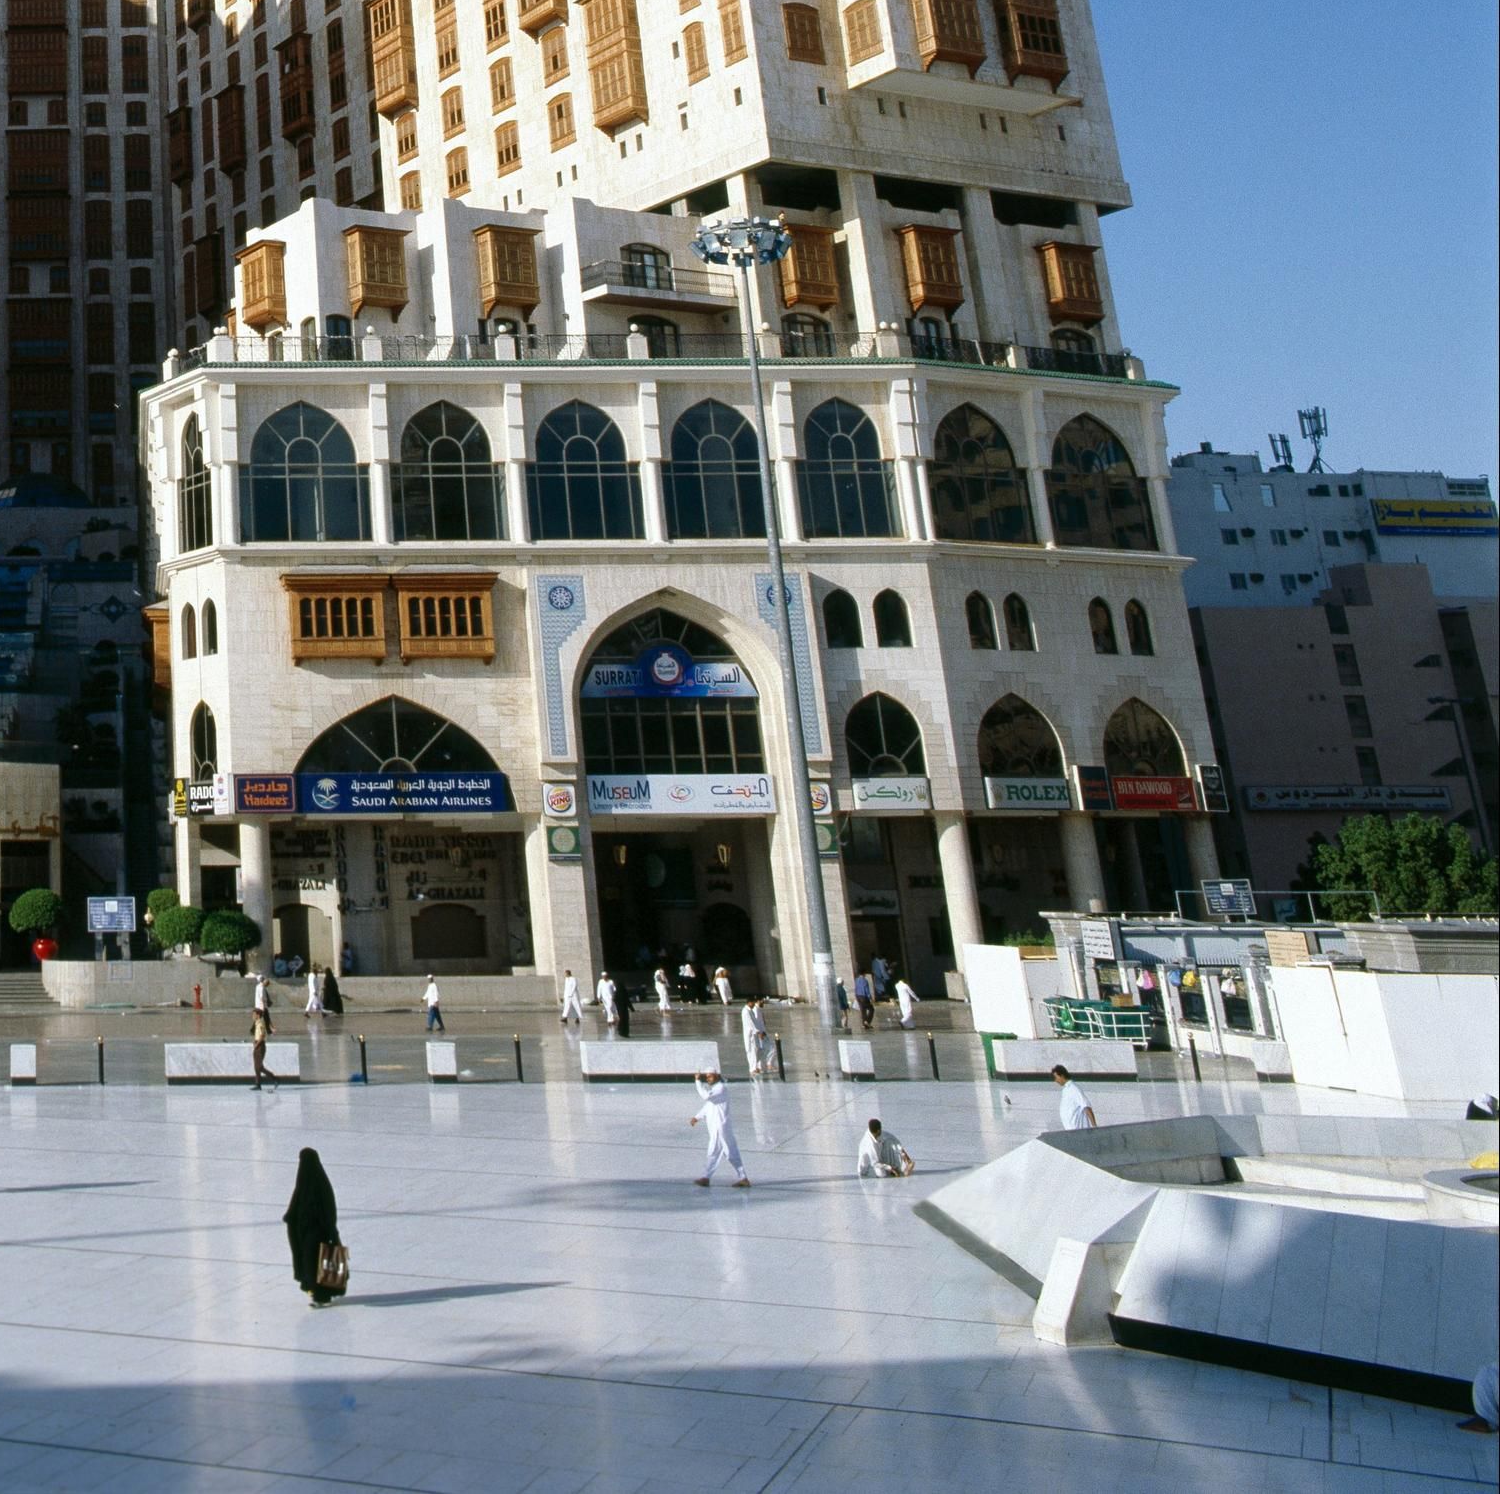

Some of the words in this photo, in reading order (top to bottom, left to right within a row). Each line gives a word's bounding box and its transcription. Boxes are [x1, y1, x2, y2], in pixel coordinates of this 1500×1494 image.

[350, 780, 394, 793] السعودية
[427, 779, 455, 792] الجوية
[457, 779, 491, 792] الخطوط
[1116, 780, 1135, 795] BIN
[1136, 780, 1173, 795] DAWOOD
[189, 786, 214, 800] RADO
[1007, 784, 1068, 801] ROLEX
[351, 796, 386, 807] SAUDI
[389, 796, 438, 806] ARABIAN
[441, 796, 492, 806] AIRLINES
[550, 795, 572, 807] KING
